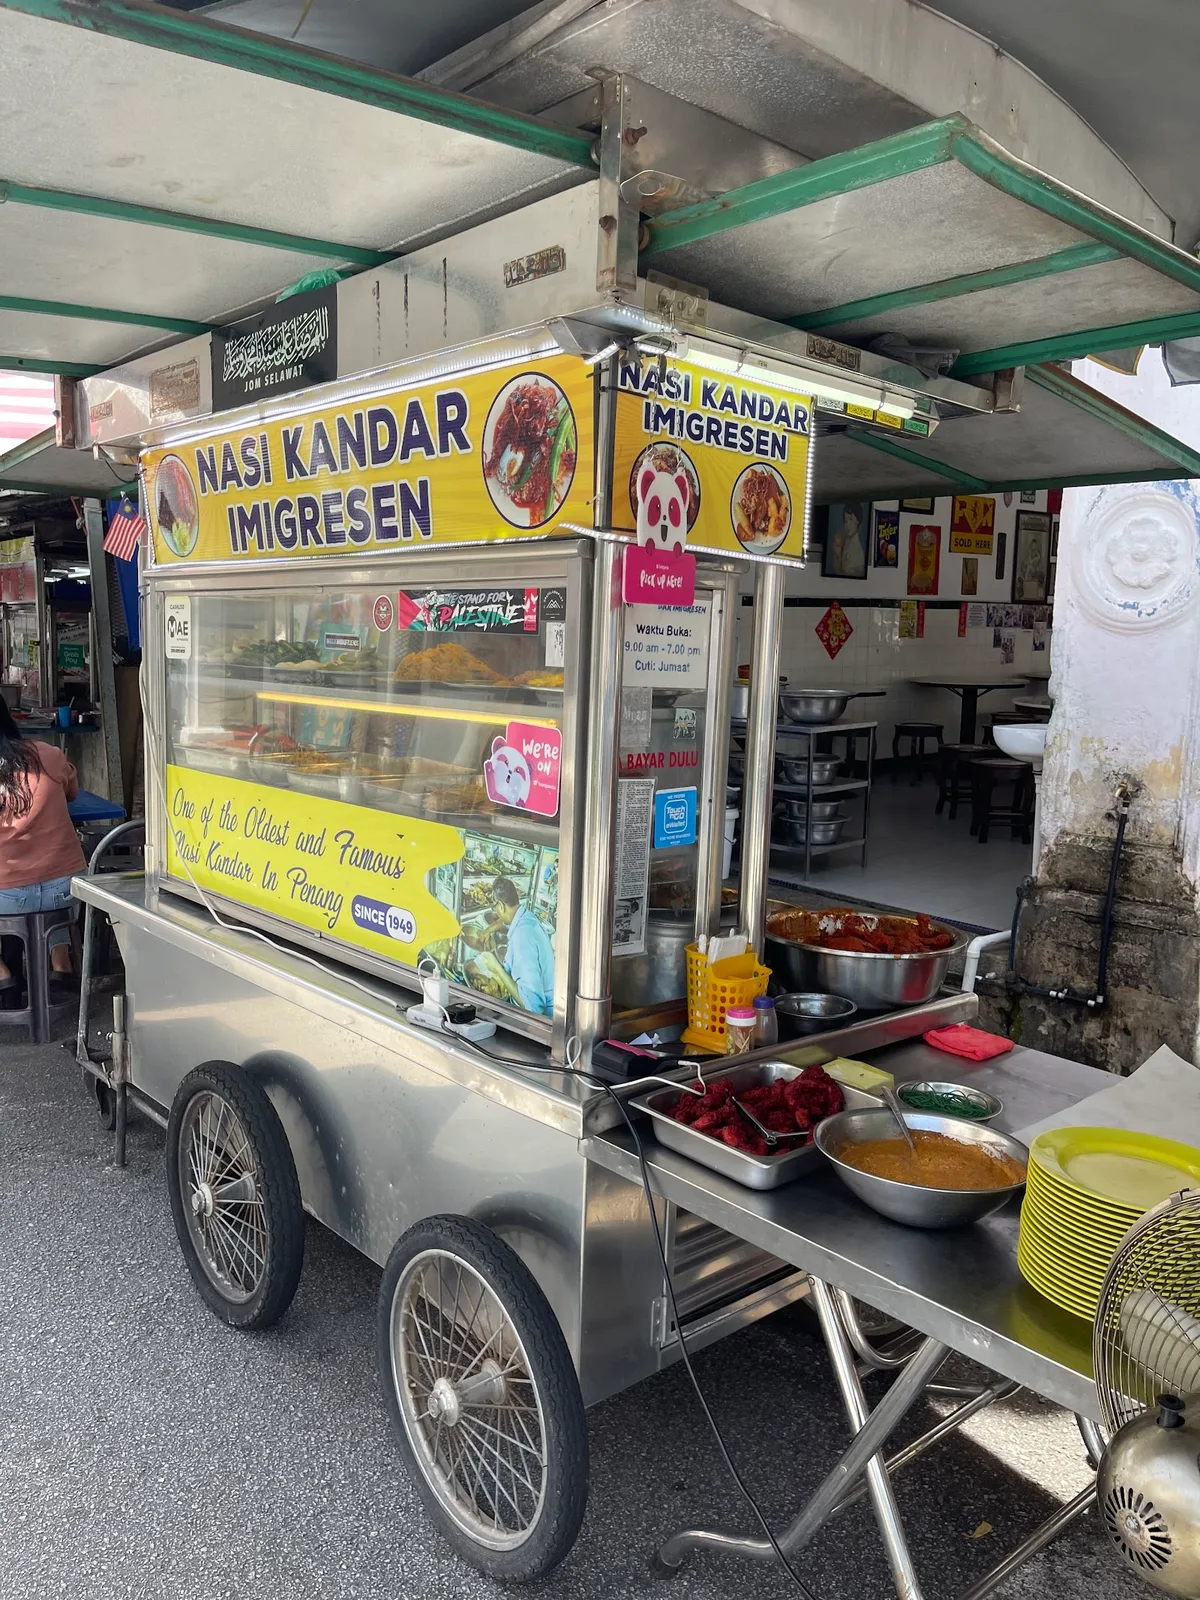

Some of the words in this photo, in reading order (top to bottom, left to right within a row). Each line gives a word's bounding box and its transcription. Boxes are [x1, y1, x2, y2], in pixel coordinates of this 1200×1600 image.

[244, 378, 261, 392] JOM
[264, 364, 304, 386] SELAWAT
[620, 363, 691, 402] NASI
[701, 379, 808, 432] KANDAR
[195, 436, 272, 494] NASI
[282, 390, 470, 479] KANDAR
[644, 402, 787, 460] IMIGRESEN
[227, 478, 432, 553] IMIGRESEN
[954, 538, 972, 547] SOLD
[975, 540, 991, 549] HERE
[457, 593, 486, 605] STAND
[487, 591, 506, 603] FOR
[439, 604, 525, 630] PALESTINE
[636, 624, 664, 635] Waktu
[666, 625, 692, 637] Buka:
[625, 641, 643, 652] 9.00
[646, 644, 659, 653] am
[667, 643, 685, 655] 7.00
[687, 647, 701, 656] pm
[635, 660, 656, 671] Cuti:
[658, 661, 691, 672] Jumaat
[627, 752, 665, 770] BAYAR
[669, 750, 699, 767] DULU
[666, 805, 686, 815] Touch
[173, 787, 195, 819] One
[200, 797, 214, 839] of
[219, 800, 238, 832] the
[243, 806, 290, 846] Oldest
[295, 828, 327, 857] and
[334, 829, 406, 879] Famous
[175, 830, 201, 864] Nasi
[205, 841, 254, 883] Kandar
[261, 861, 279, 891] In
[286, 867, 344, 929] Penang
[354, 903, 385, 927] SINCE
[388, 913, 414, 935] 1949
